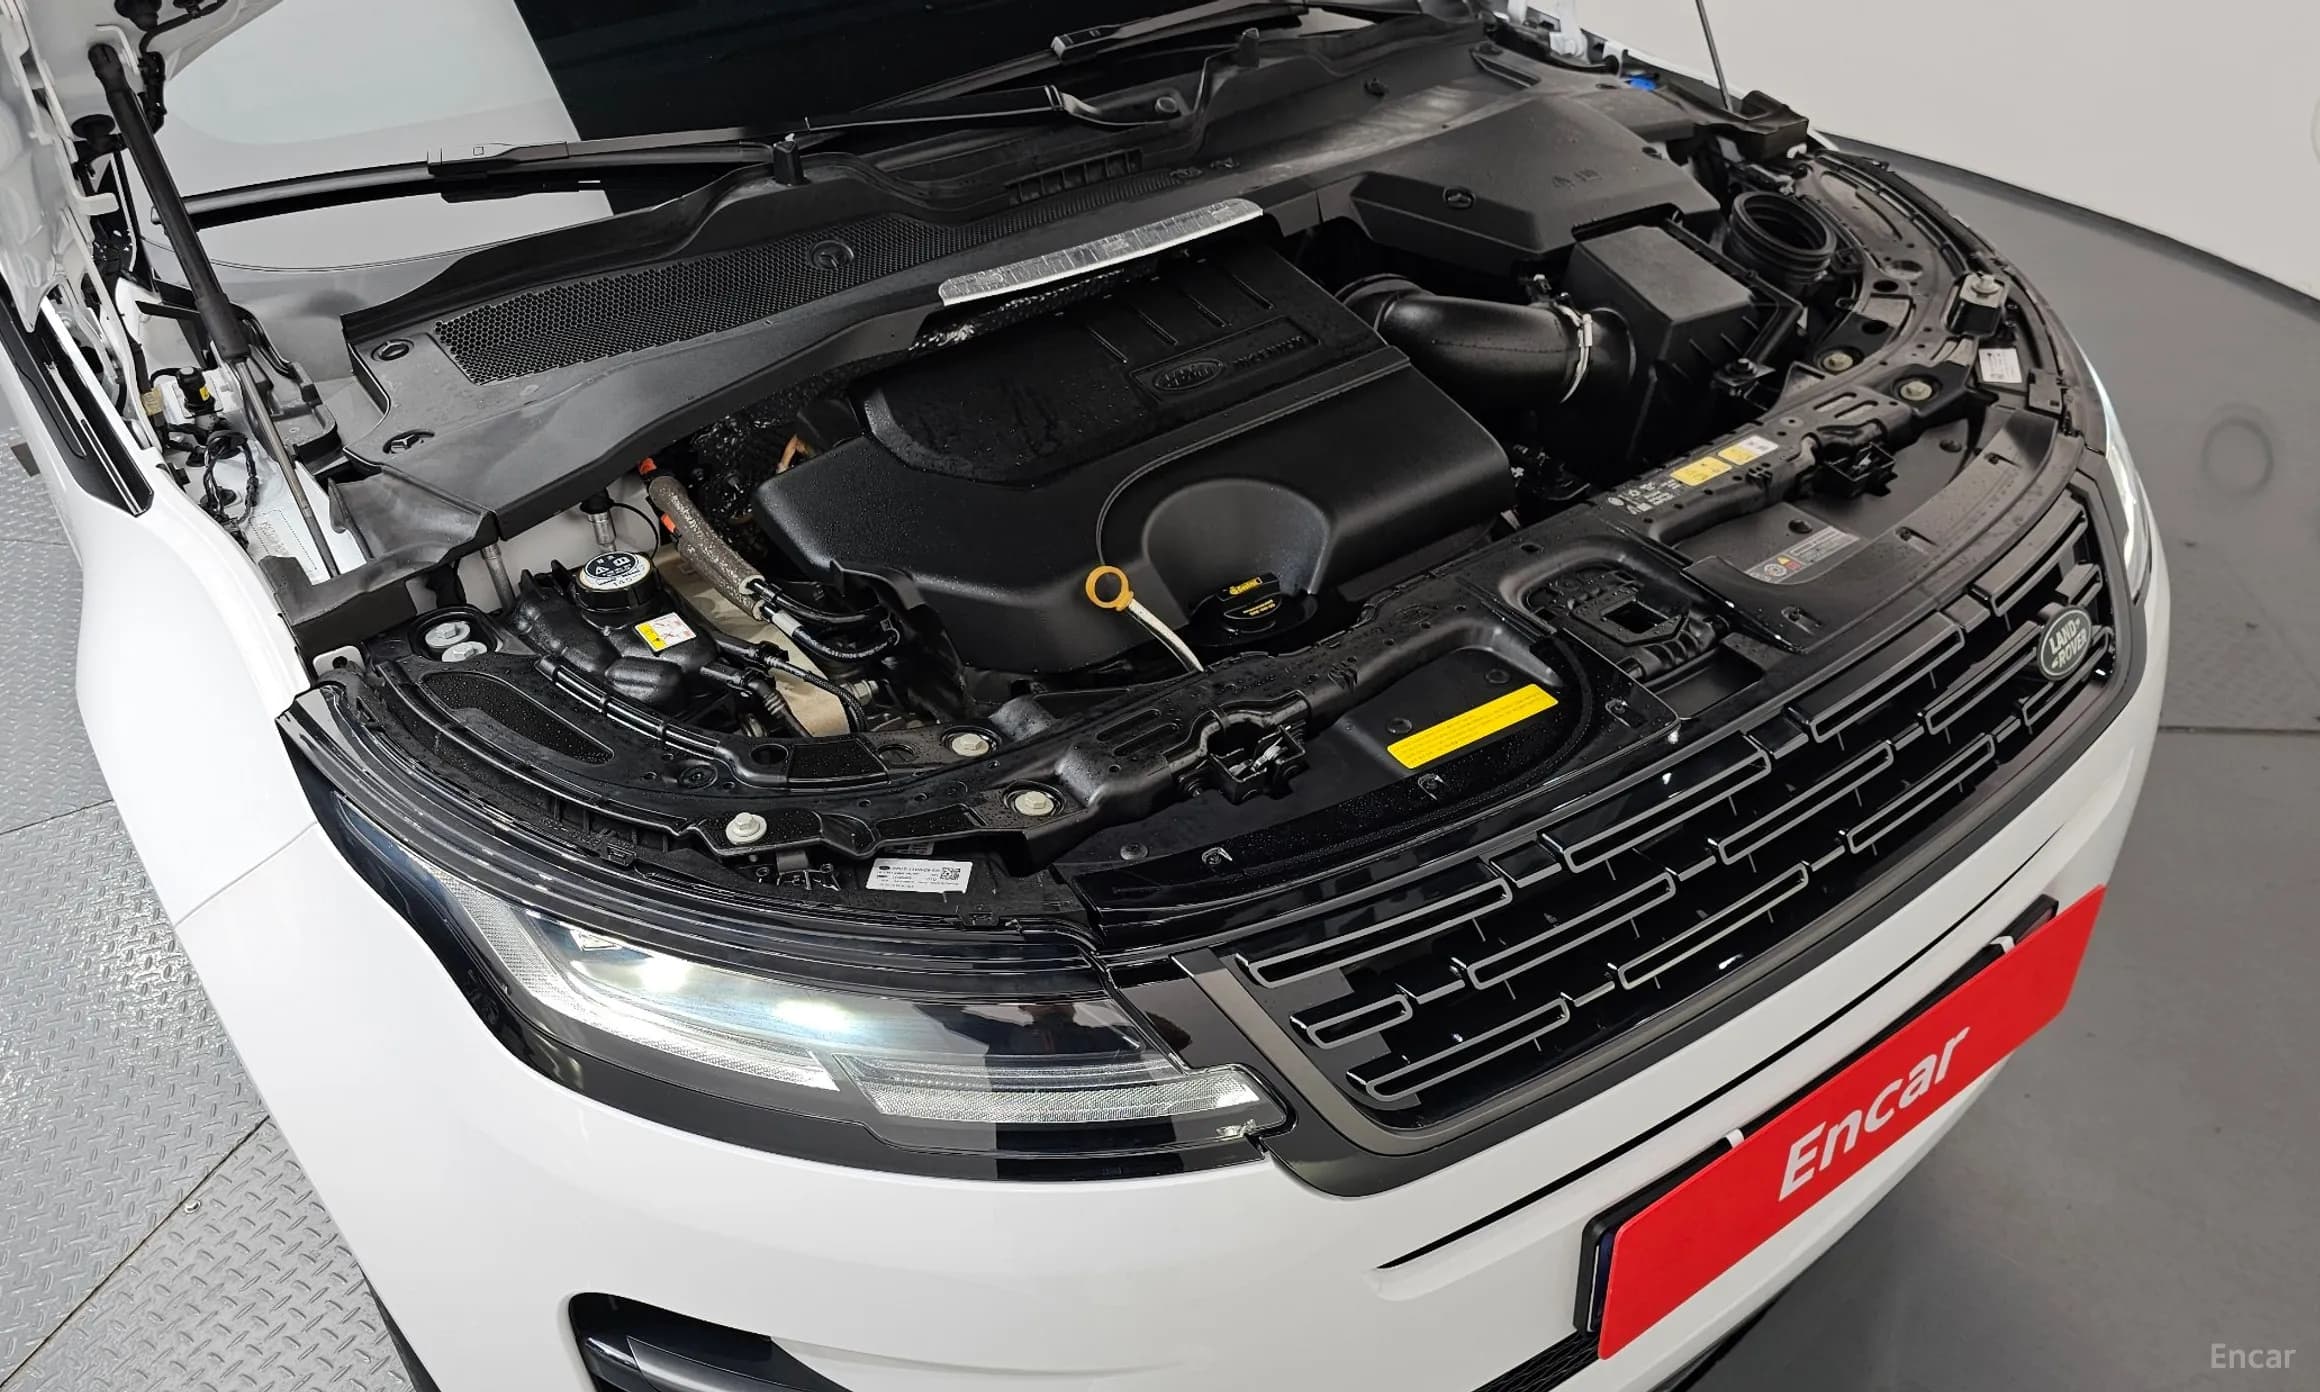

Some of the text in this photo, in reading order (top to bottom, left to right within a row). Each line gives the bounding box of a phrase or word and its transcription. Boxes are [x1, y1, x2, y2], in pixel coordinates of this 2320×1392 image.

[2049, 620, 2076, 654] LAND
[2058, 628, 2087, 668] ROVER
[1778, 1026, 1971, 1202] Encar
